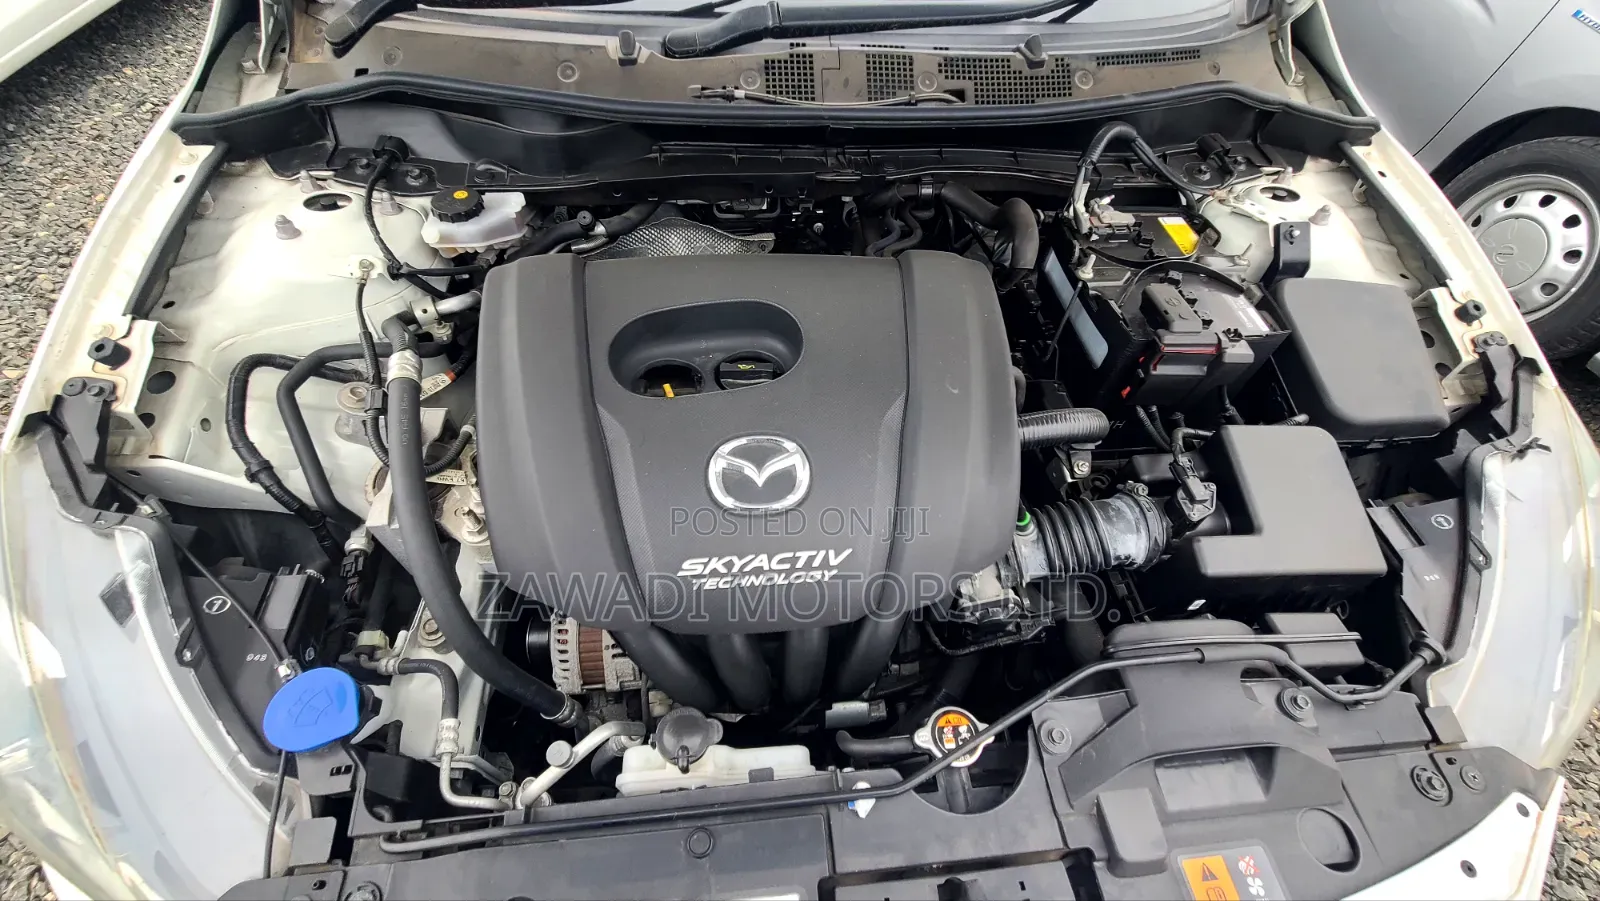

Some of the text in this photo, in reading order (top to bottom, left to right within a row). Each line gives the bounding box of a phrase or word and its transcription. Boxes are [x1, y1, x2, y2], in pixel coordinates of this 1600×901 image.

[1579, 13, 1600, 31] HYB
[677, 548, 852, 577] SKYACTIV
[692, 568, 839, 591] TECHNOLOGY
